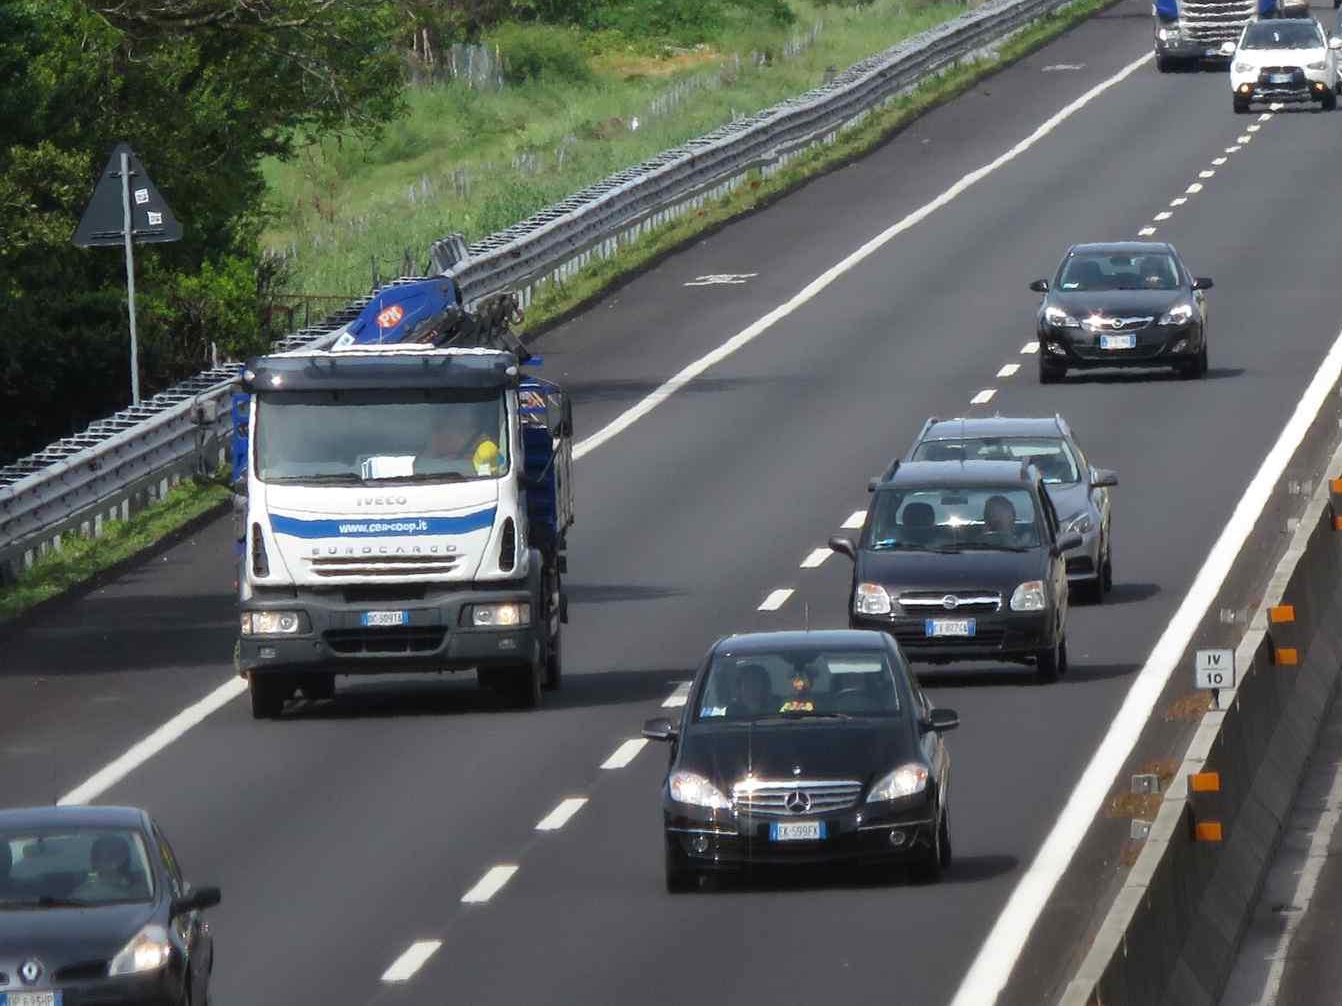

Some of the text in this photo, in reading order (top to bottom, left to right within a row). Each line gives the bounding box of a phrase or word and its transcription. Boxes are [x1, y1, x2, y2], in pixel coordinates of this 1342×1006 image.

[356, 496, 408, 506] IVECO
[311, 545, 457, 556] EUROCARGO
[1207, 654, 1221, 666] IV
[1207, 673, 1223, 684] 10
